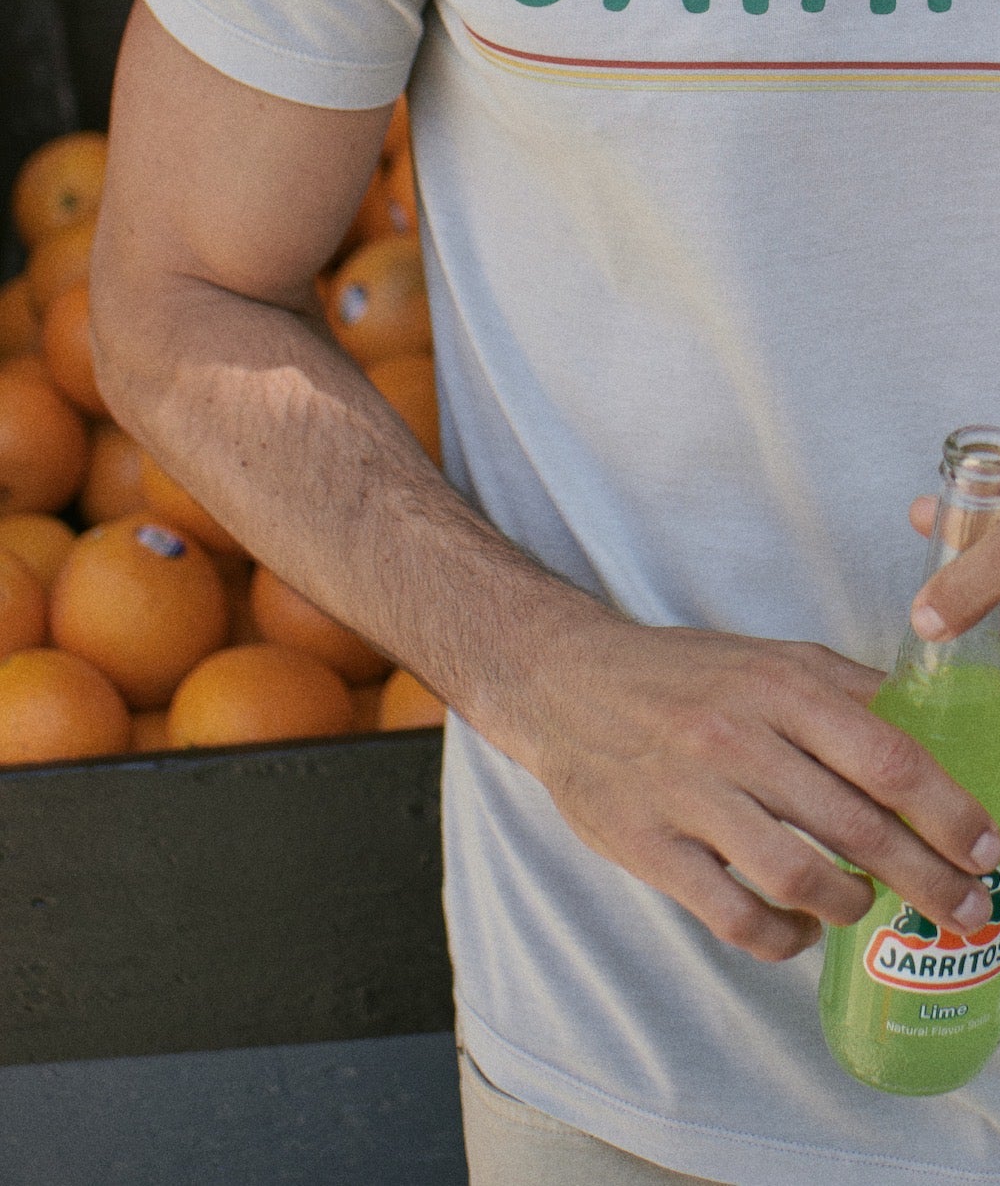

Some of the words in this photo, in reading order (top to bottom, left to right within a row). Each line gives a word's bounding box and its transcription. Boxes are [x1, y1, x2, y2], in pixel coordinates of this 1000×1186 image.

[919, 1004, 968, 1020] Lime
[886, 1020, 928, 1036] Natural
[931, 1024, 965, 1036] Flavor
